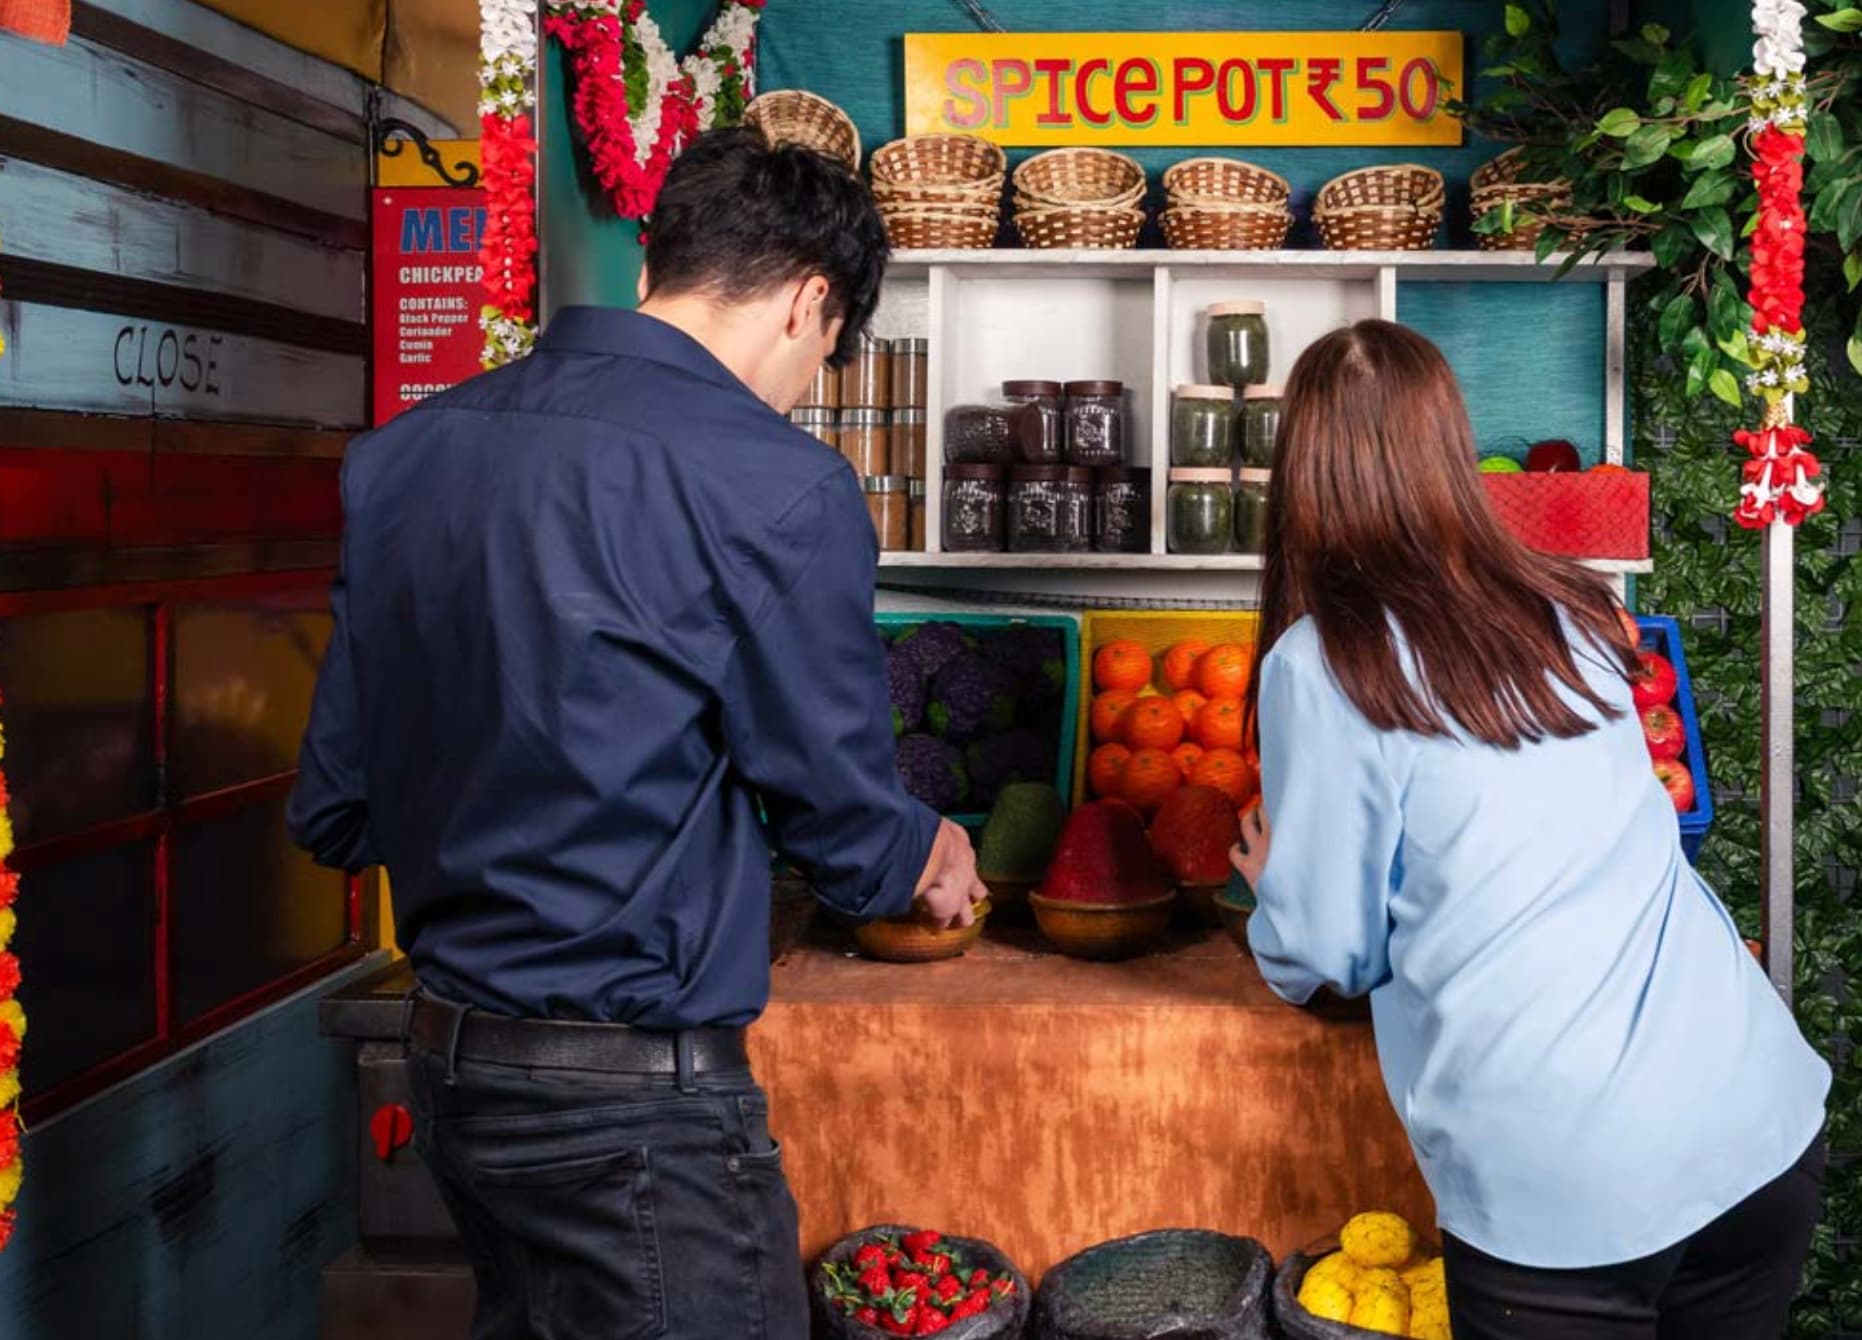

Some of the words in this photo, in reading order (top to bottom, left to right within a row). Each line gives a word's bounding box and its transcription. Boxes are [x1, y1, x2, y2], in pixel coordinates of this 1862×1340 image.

[1173, 57, 1299, 125] POT
[400, 297, 468, 310] CONTAINS:
[400, 313, 428, 324] Black
[431, 313, 468, 325] Pepper
[400, 327, 452, 337] Coriander
[400, 340, 433, 350] Cumin
[114, 326, 223, 396] CLOSE
[400, 353, 432, 363] Garlic
